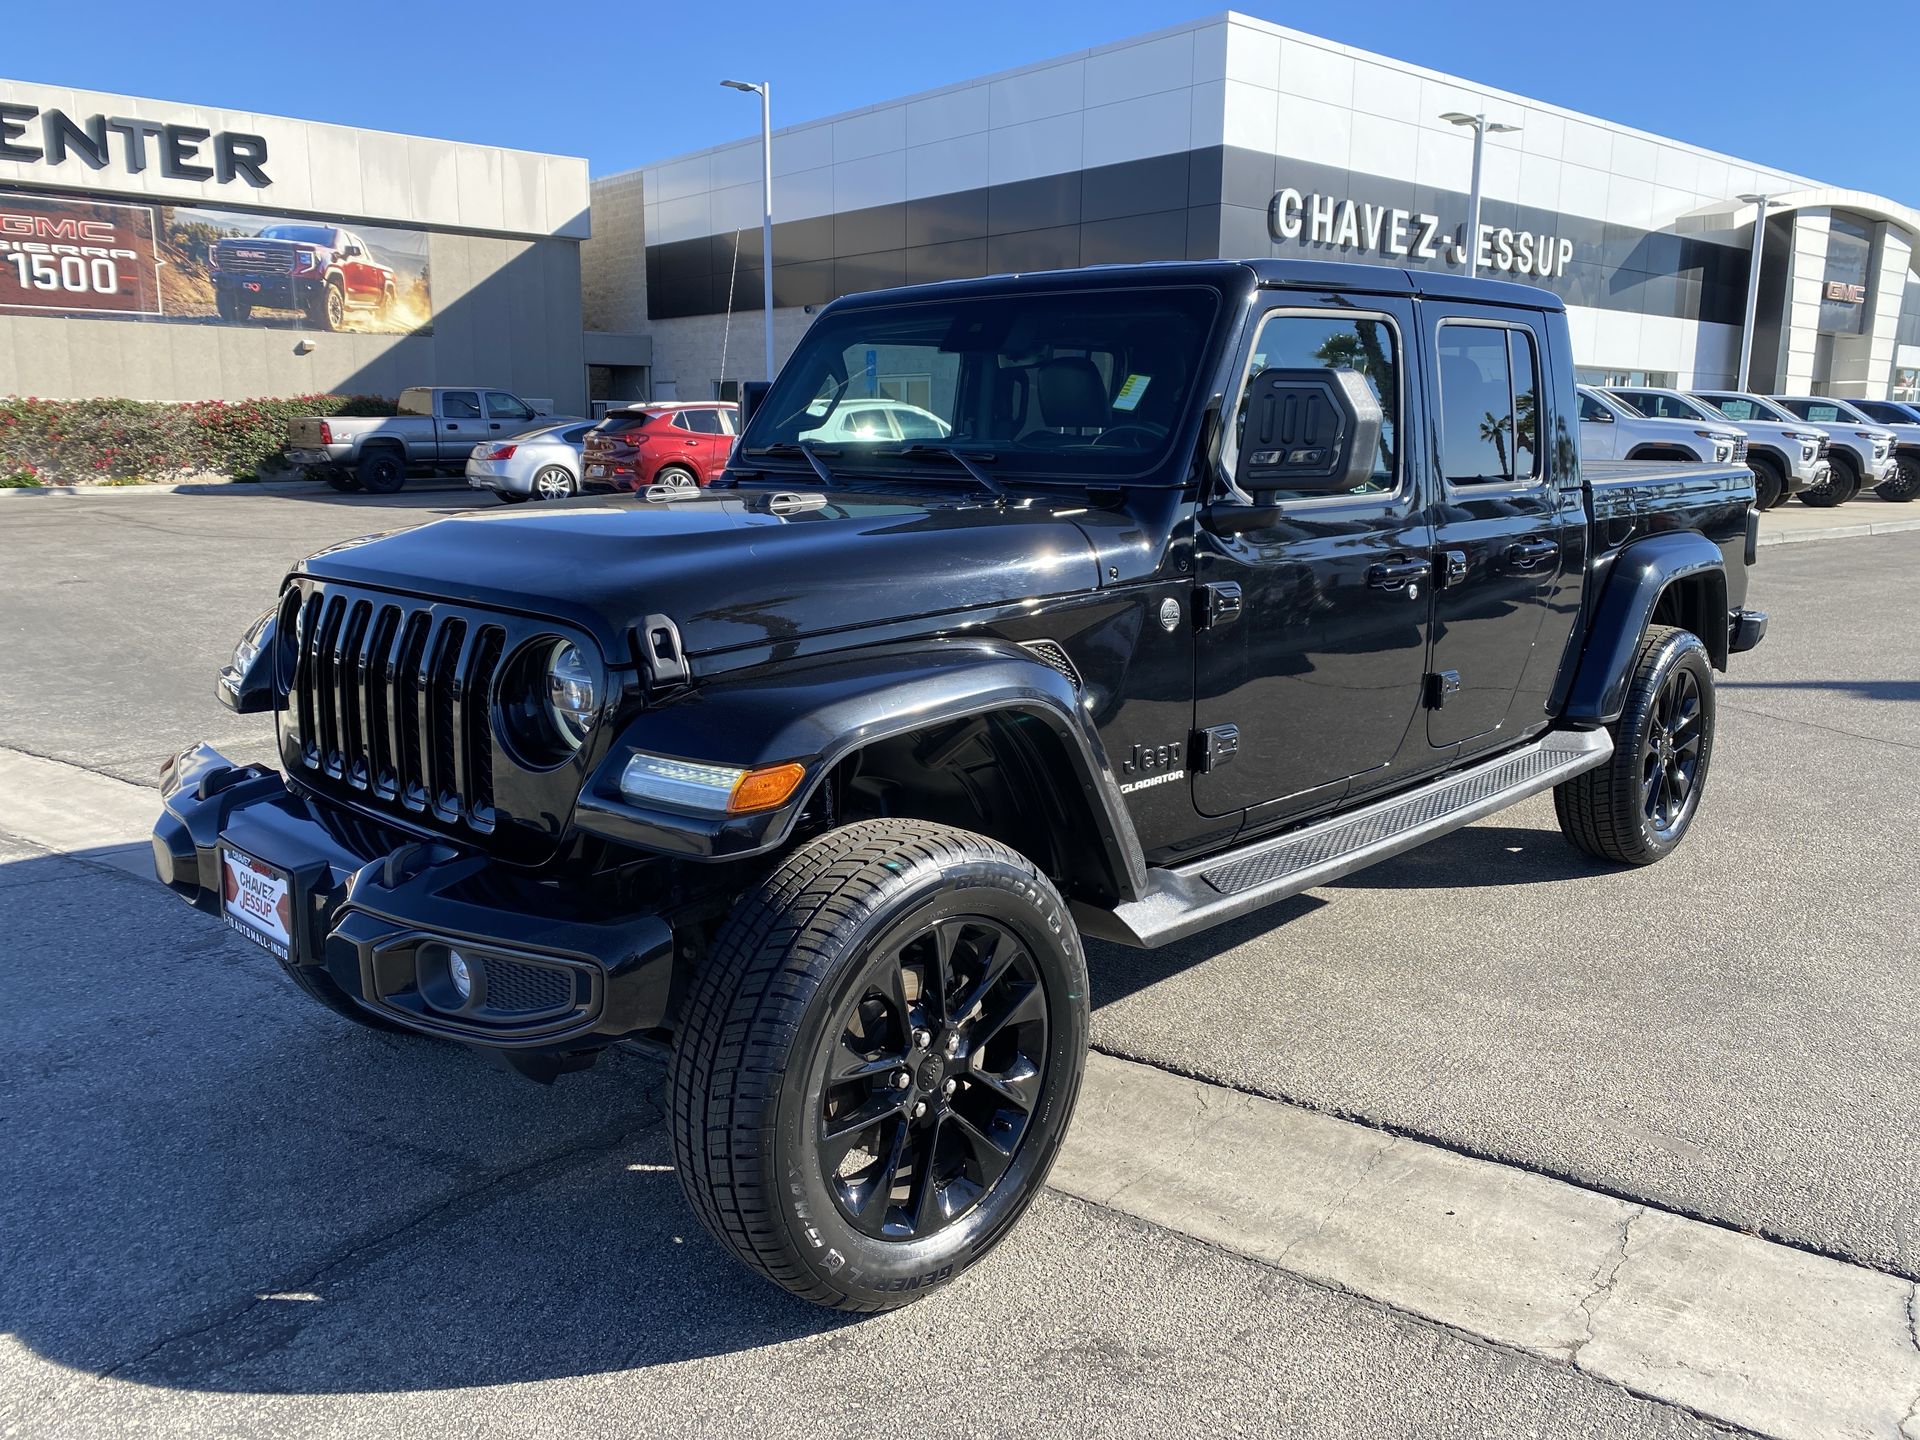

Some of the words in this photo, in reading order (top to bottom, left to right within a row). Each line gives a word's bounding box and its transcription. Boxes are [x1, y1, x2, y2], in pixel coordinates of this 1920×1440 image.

[0, 101, 273, 188] ENTER
[0, 213, 115, 242] GMC
[7, 252, 118, 294] 1500
[1827, 281, 1866, 303] GMC
[1123, 742, 1181, 774] Jeep
[1120, 770, 1184, 794] GLADIATOR
[239, 889, 272, 918] JESSUP
